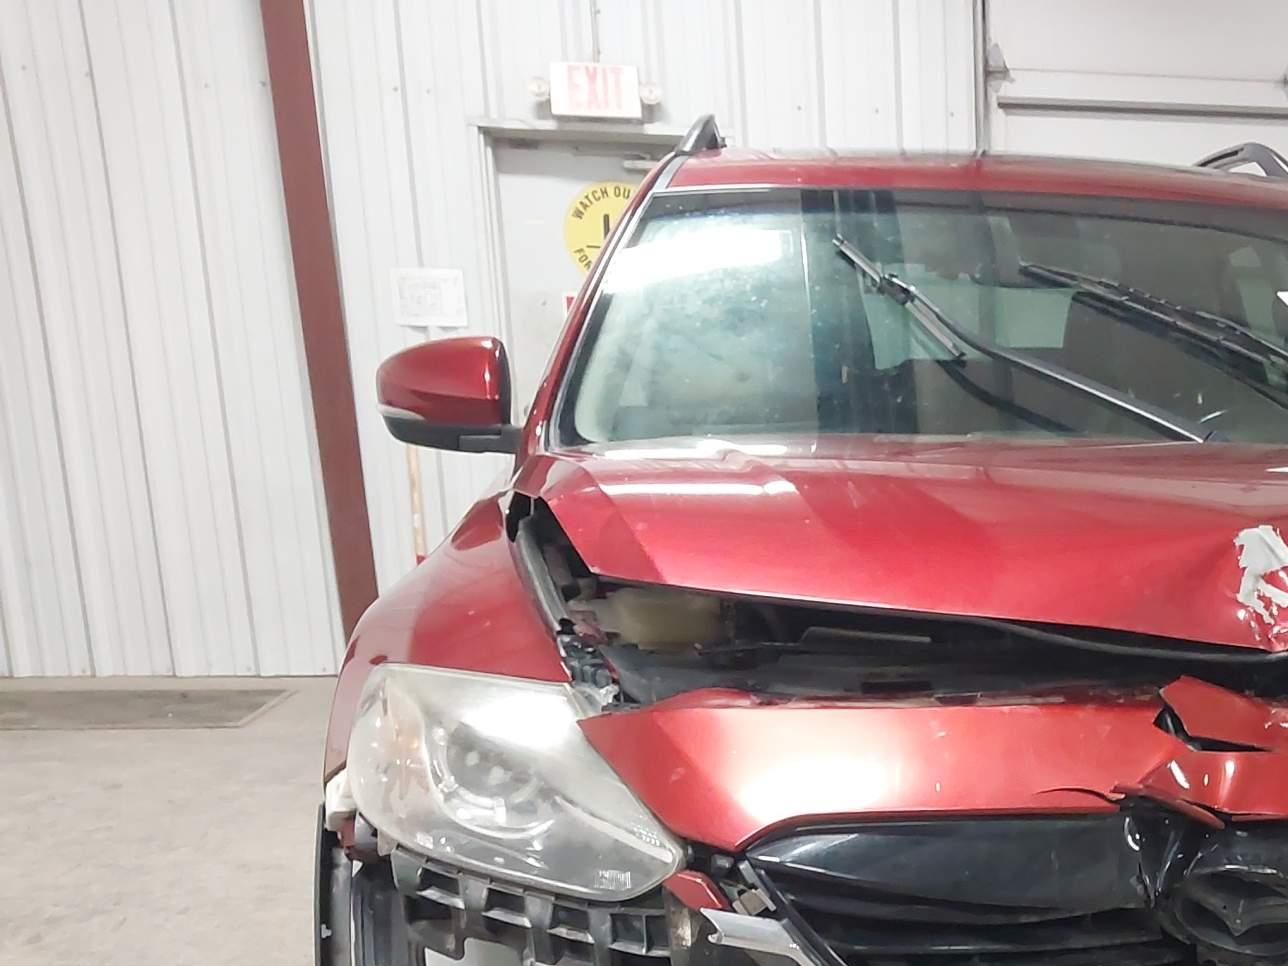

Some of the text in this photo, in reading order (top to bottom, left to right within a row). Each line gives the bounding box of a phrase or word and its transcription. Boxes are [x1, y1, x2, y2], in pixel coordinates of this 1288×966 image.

[567, 65, 624, 110] EXIT
[572, 185, 632, 220] WATCH OU
